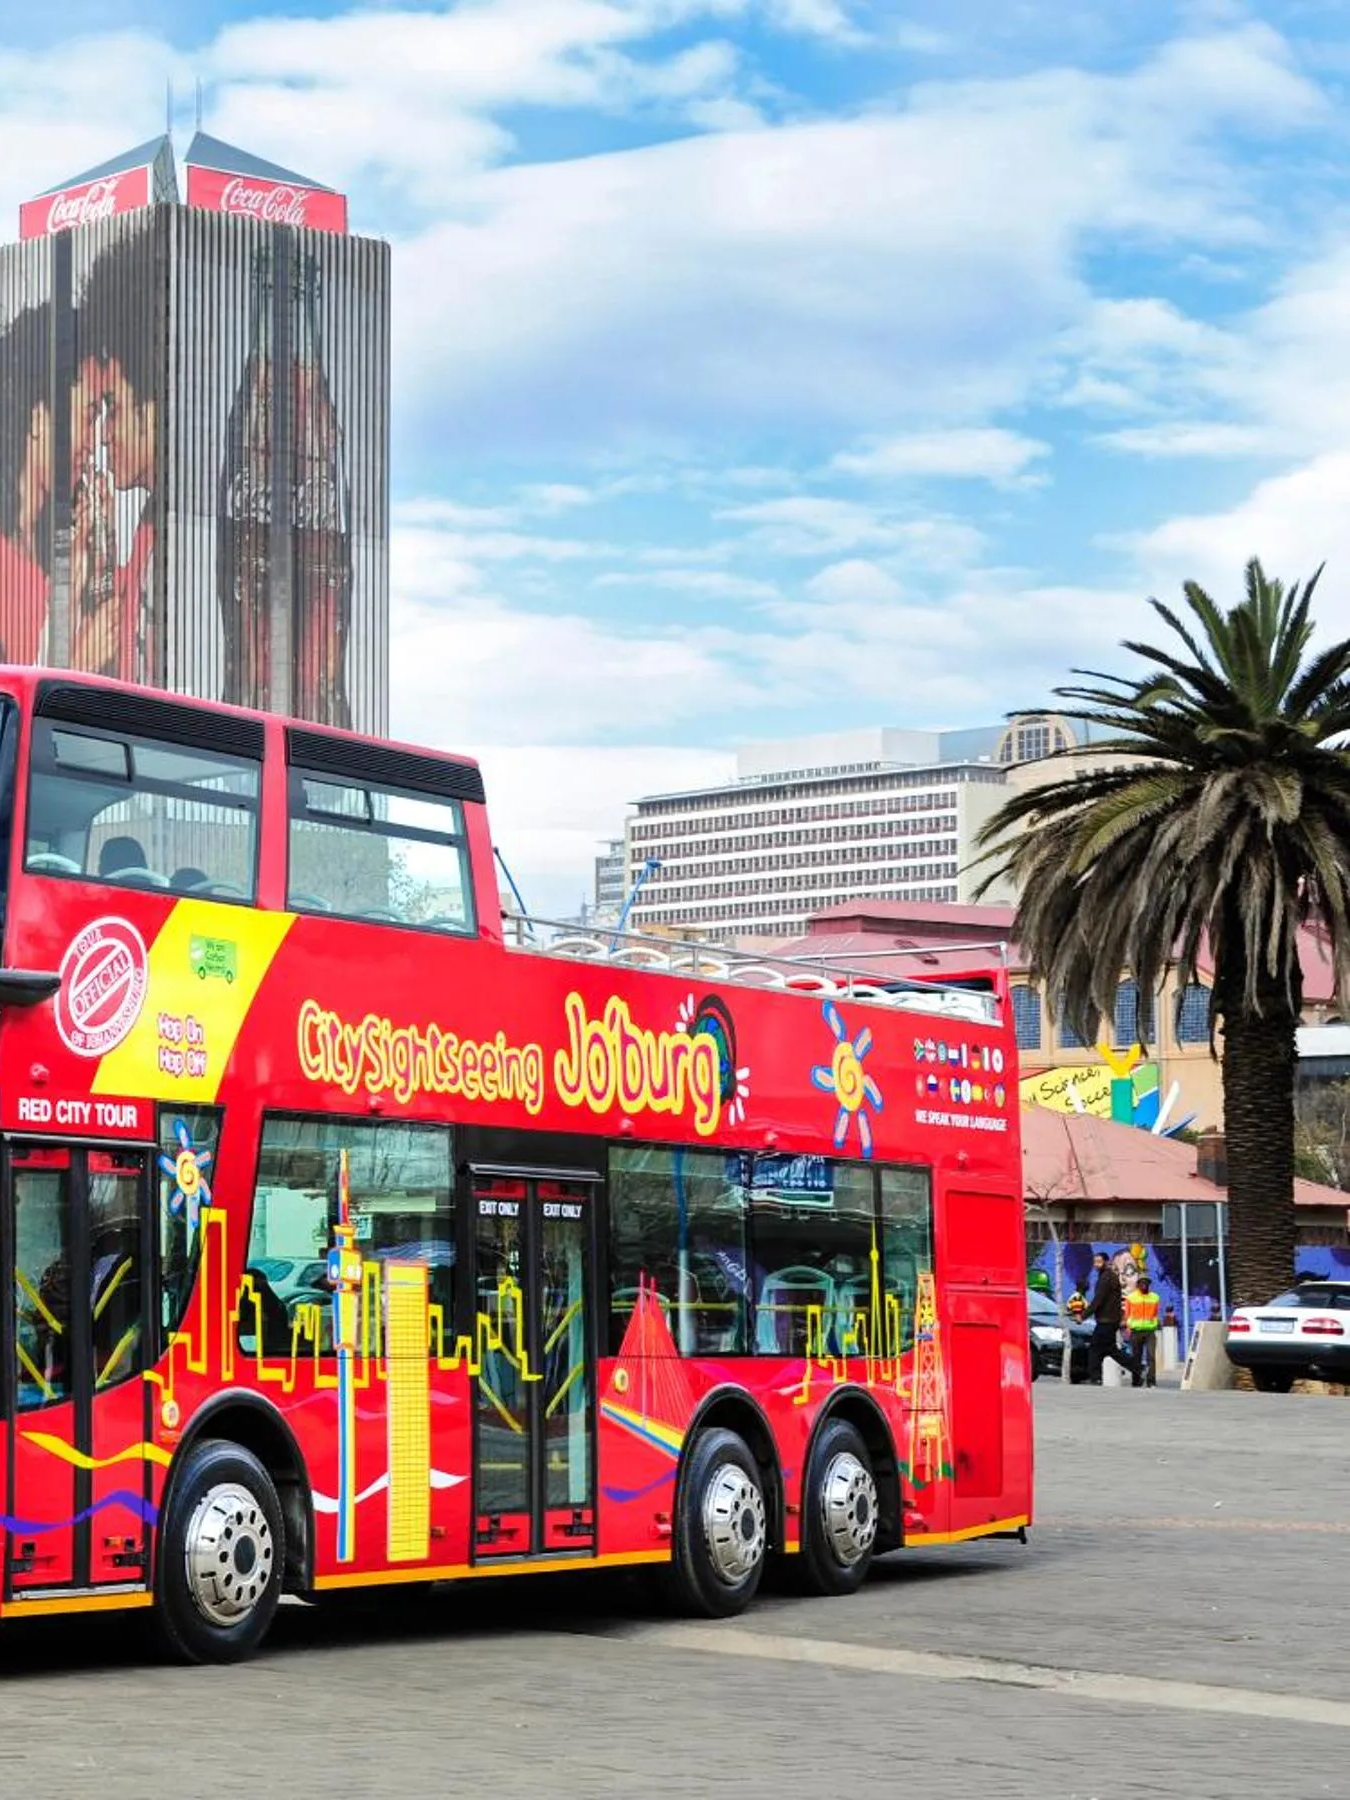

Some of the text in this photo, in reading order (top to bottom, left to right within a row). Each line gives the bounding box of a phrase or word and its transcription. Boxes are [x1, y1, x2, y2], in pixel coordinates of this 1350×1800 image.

[220, 178, 309, 225] Coca-Cola
[73, 950, 129, 1020] OFFICIAL
[157, 1012, 204, 1045] Hop On
[158, 1045, 184, 1078] Hop
[18, 1098, 137, 1128] RED CITY TOUR
[479, 1200, 519, 1216] EXIT ONLY
[543, 1203, 582, 1218] EXIT ONLY
